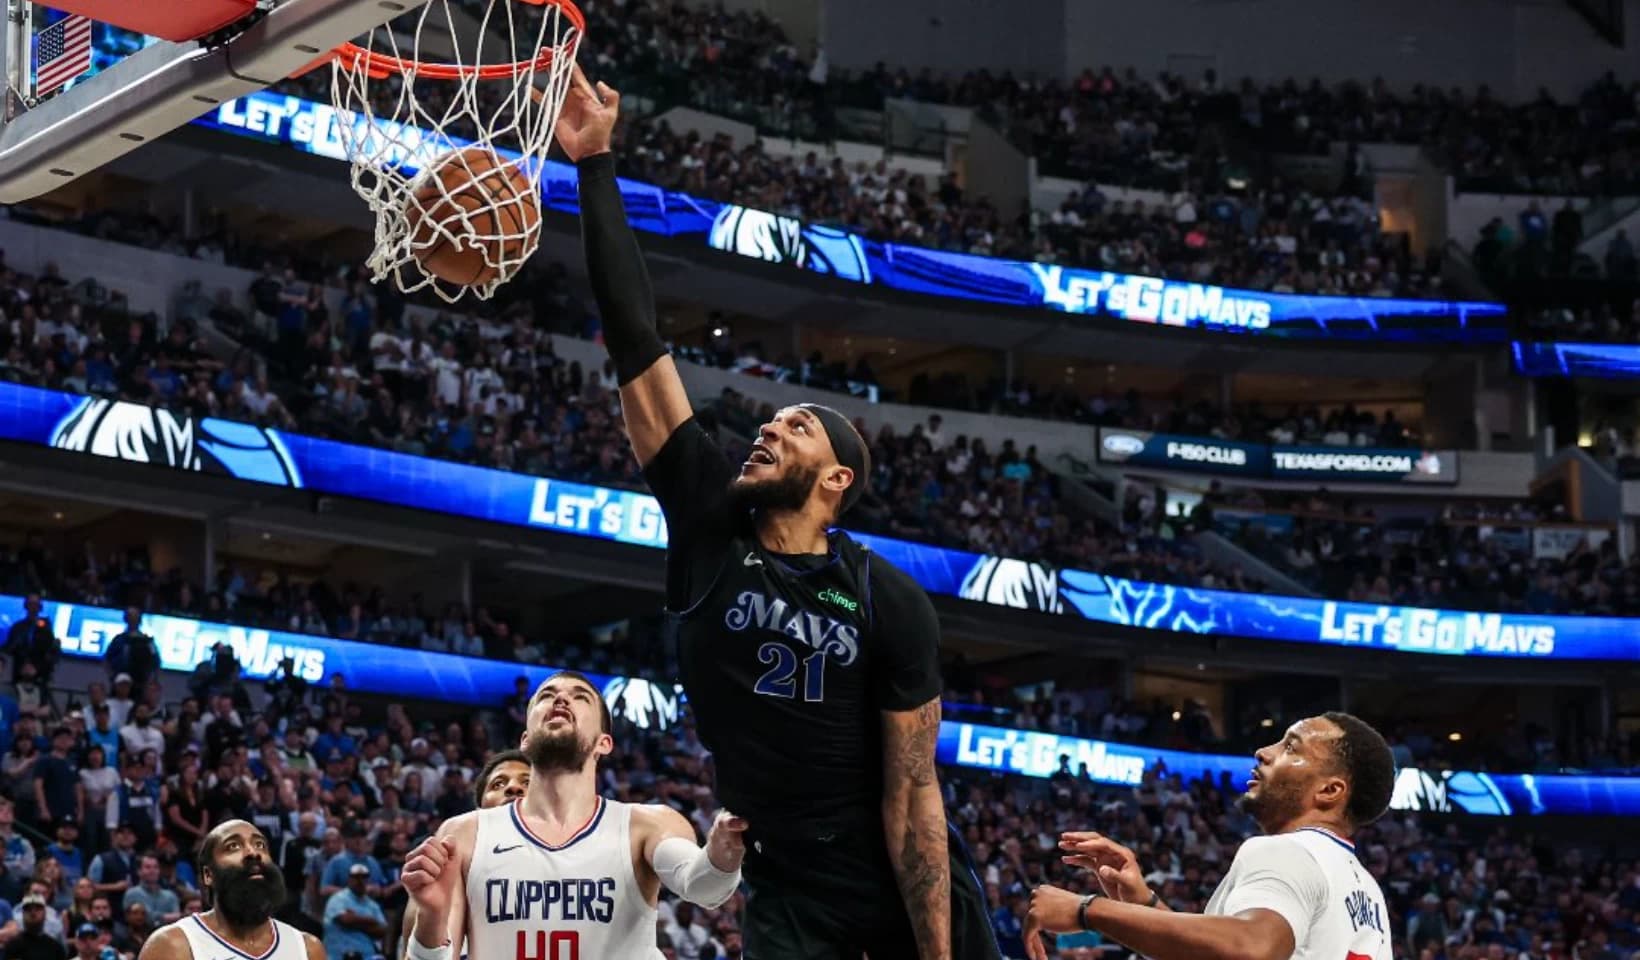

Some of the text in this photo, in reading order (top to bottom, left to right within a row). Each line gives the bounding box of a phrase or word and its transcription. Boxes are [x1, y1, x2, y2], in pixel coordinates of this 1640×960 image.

[1126, 275, 1187, 326] GO
[1189, 283, 1271, 328] MAVS
[1206, 446, 1247, 465] CLUB
[528, 477, 623, 534] LET'S
[817, 588, 857, 611] chime
[725, 591, 858, 666] MAVS
[1320, 601, 1555, 654] LET'S GO MAVS
[753, 642, 825, 702] 21
[956, 724, 1027, 770] LET'S
[486, 877, 616, 923] CLIPPERS
